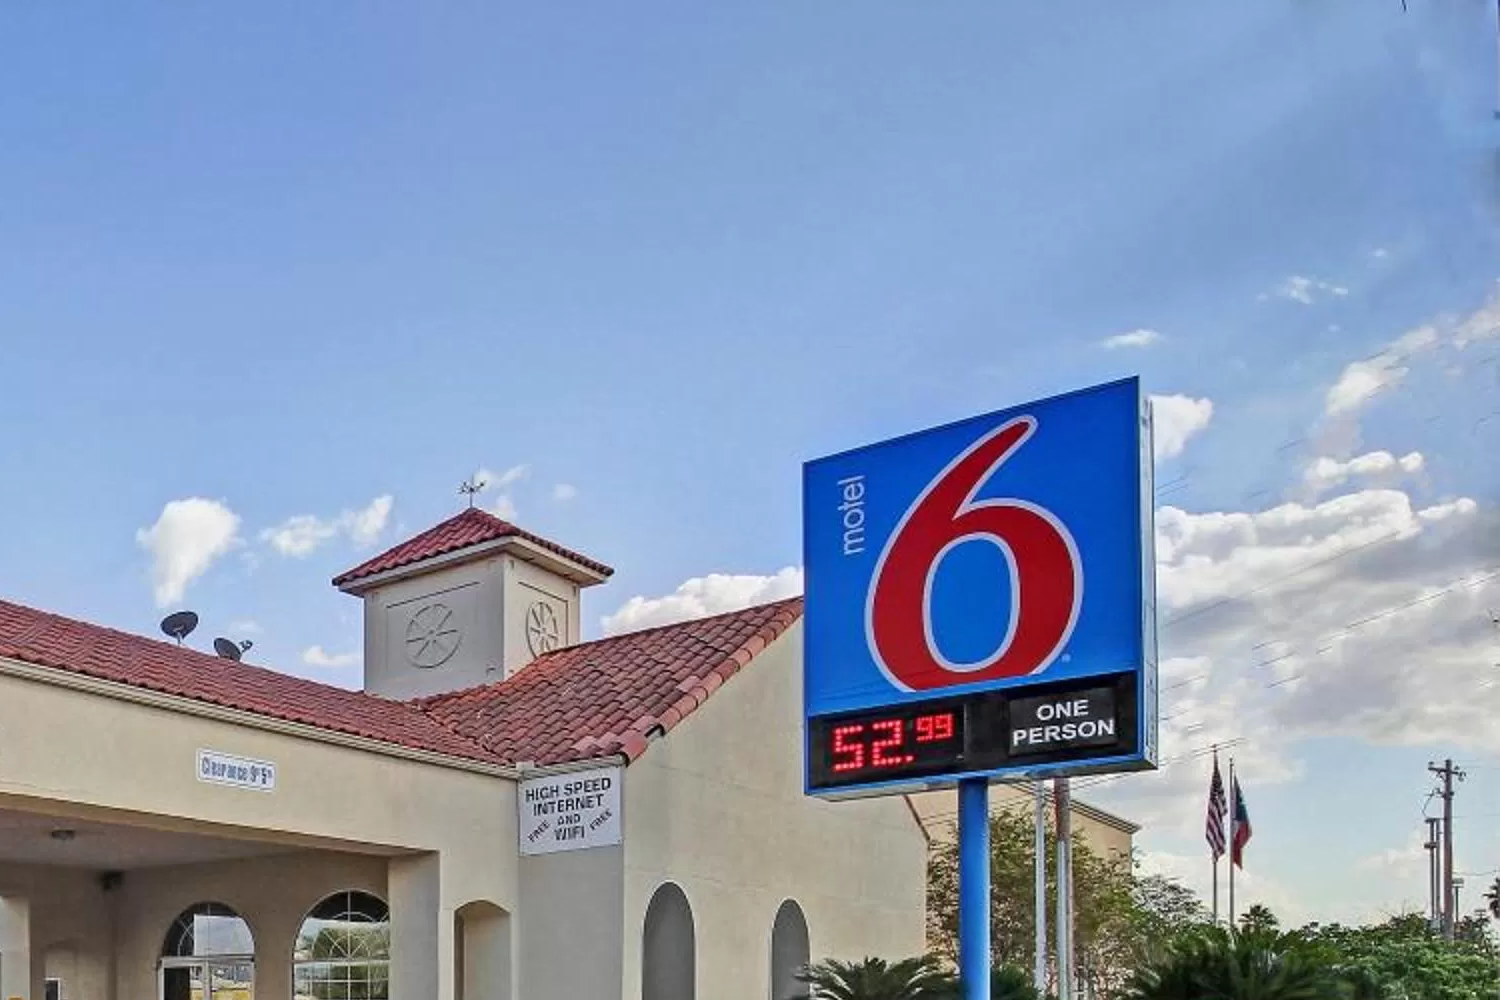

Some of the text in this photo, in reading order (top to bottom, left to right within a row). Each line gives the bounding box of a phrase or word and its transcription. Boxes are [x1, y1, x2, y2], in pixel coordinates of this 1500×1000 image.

[837, 474, 866, 557] motel
[864, 414, 1084, 693] 6
[1036, 699, 1089, 721] ONE
[1012, 719, 1115, 746] PERSON
[525, 778, 611, 803] HIGH SPEED
[533, 794, 604, 816] INTERNET
[557, 814, 581, 826] AND
